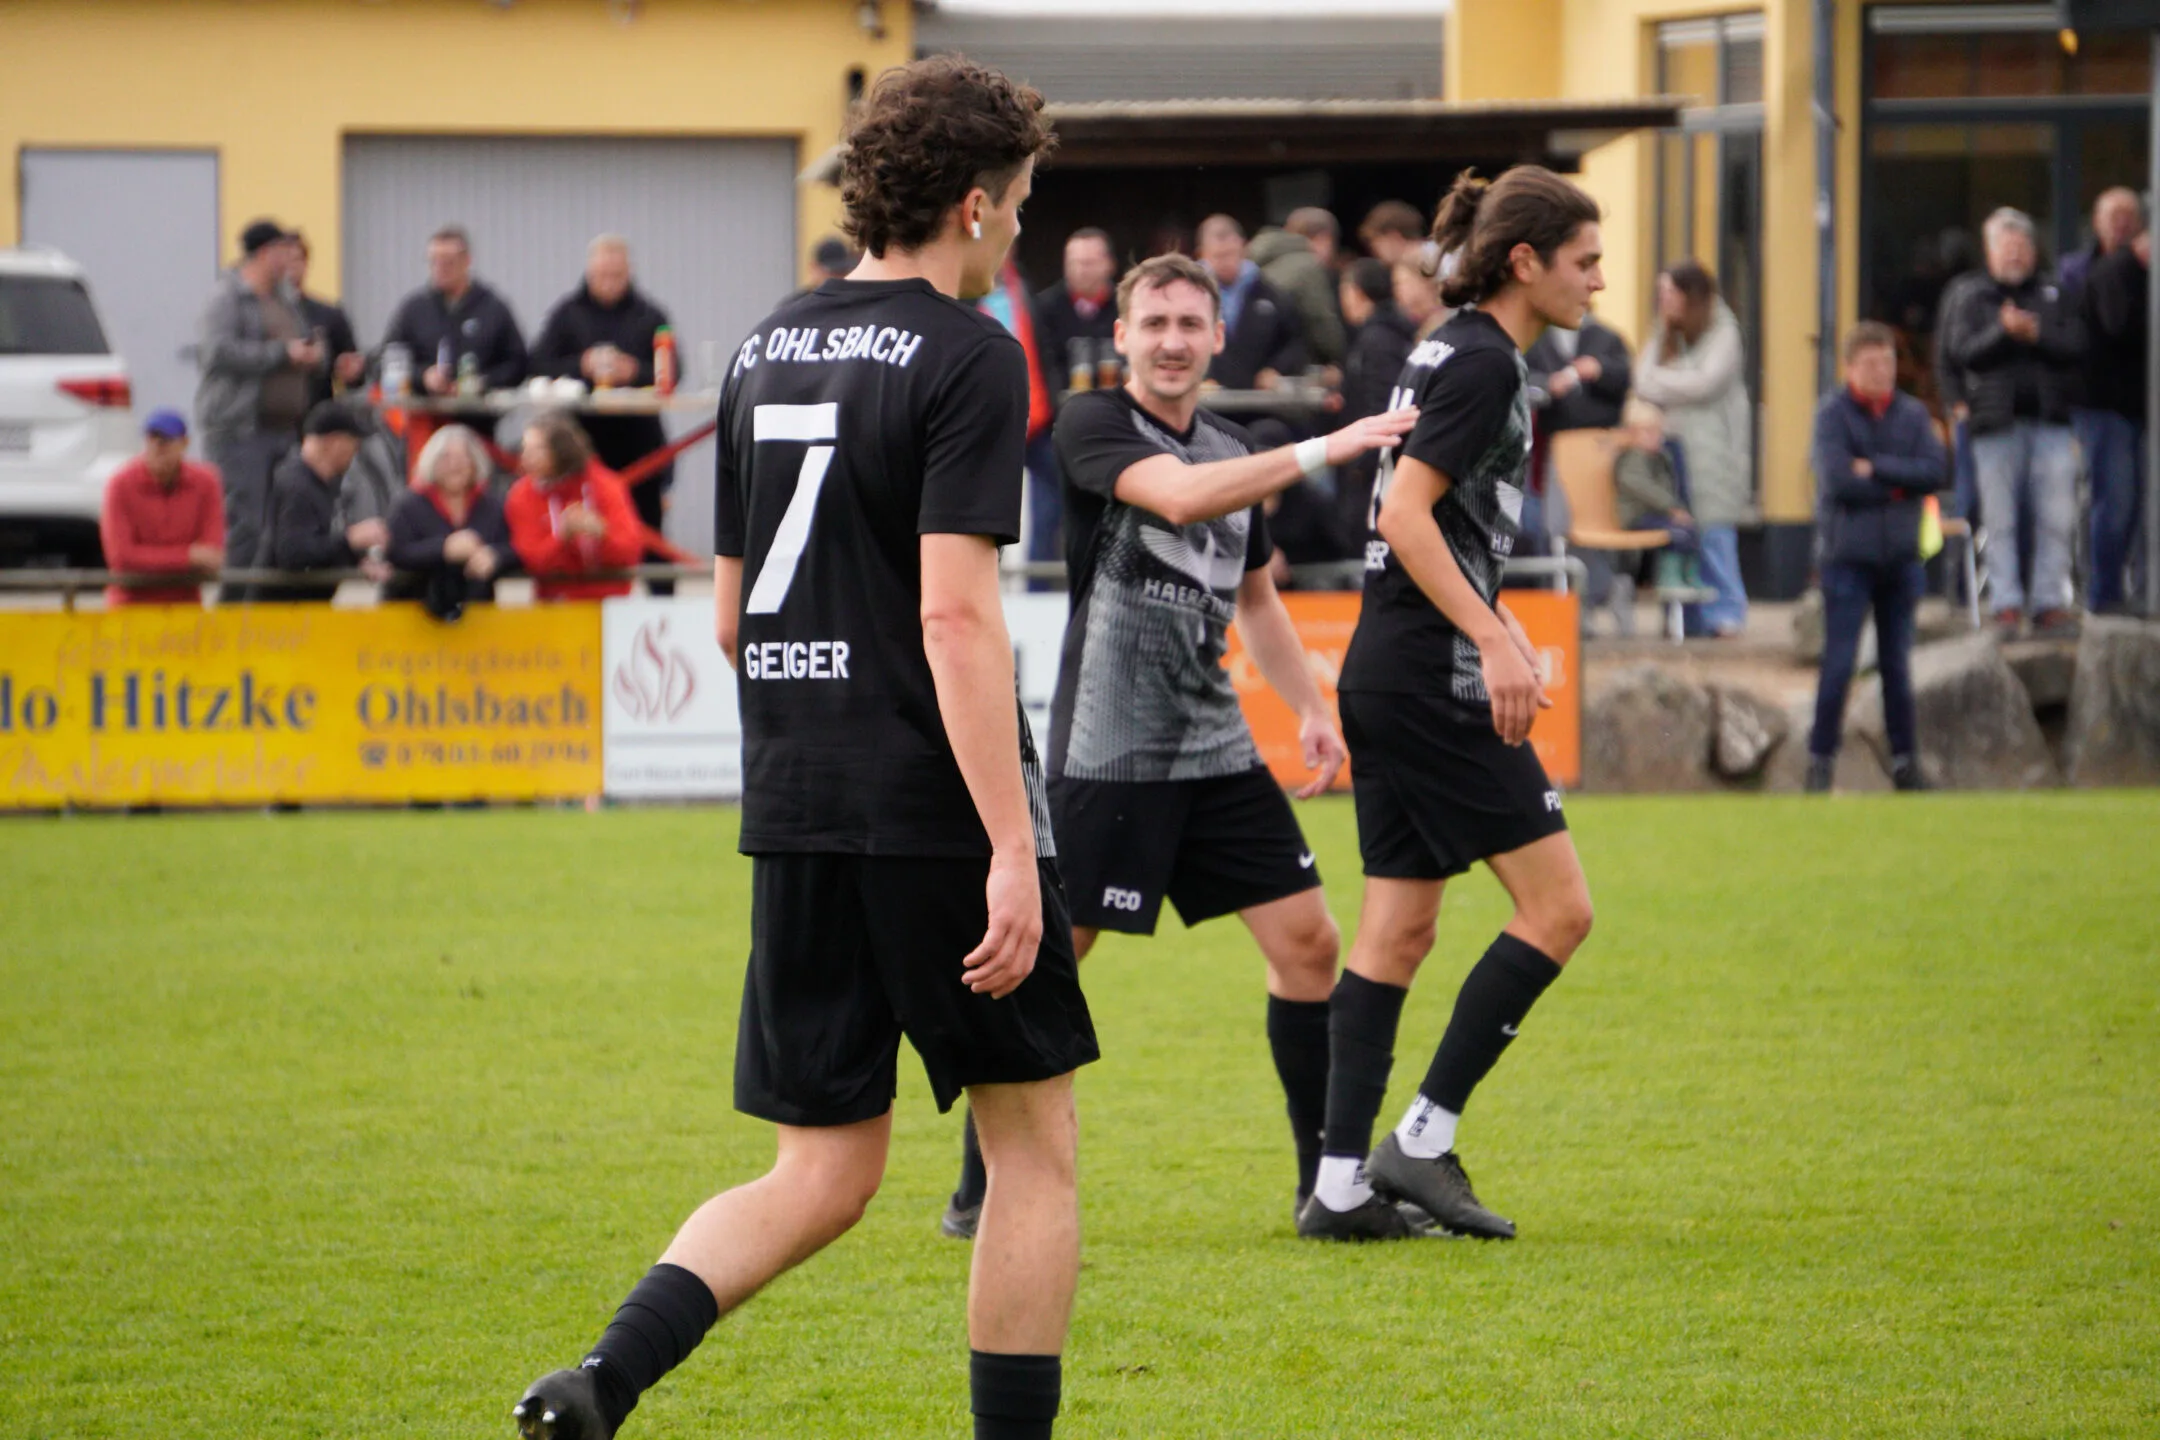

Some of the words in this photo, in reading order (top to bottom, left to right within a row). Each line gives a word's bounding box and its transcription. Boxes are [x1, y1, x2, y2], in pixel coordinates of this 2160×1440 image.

[733, 333, 761, 378] FC
[765, 324, 923, 368] OHLSBACH
[745, 402, 838, 614] 7
[744, 641, 849, 680] GEIGER
[89, 668, 317, 734] Hitzke
[356, 682, 590, 730] Ohlsbach
[1102, 886, 1142, 912] FCO
